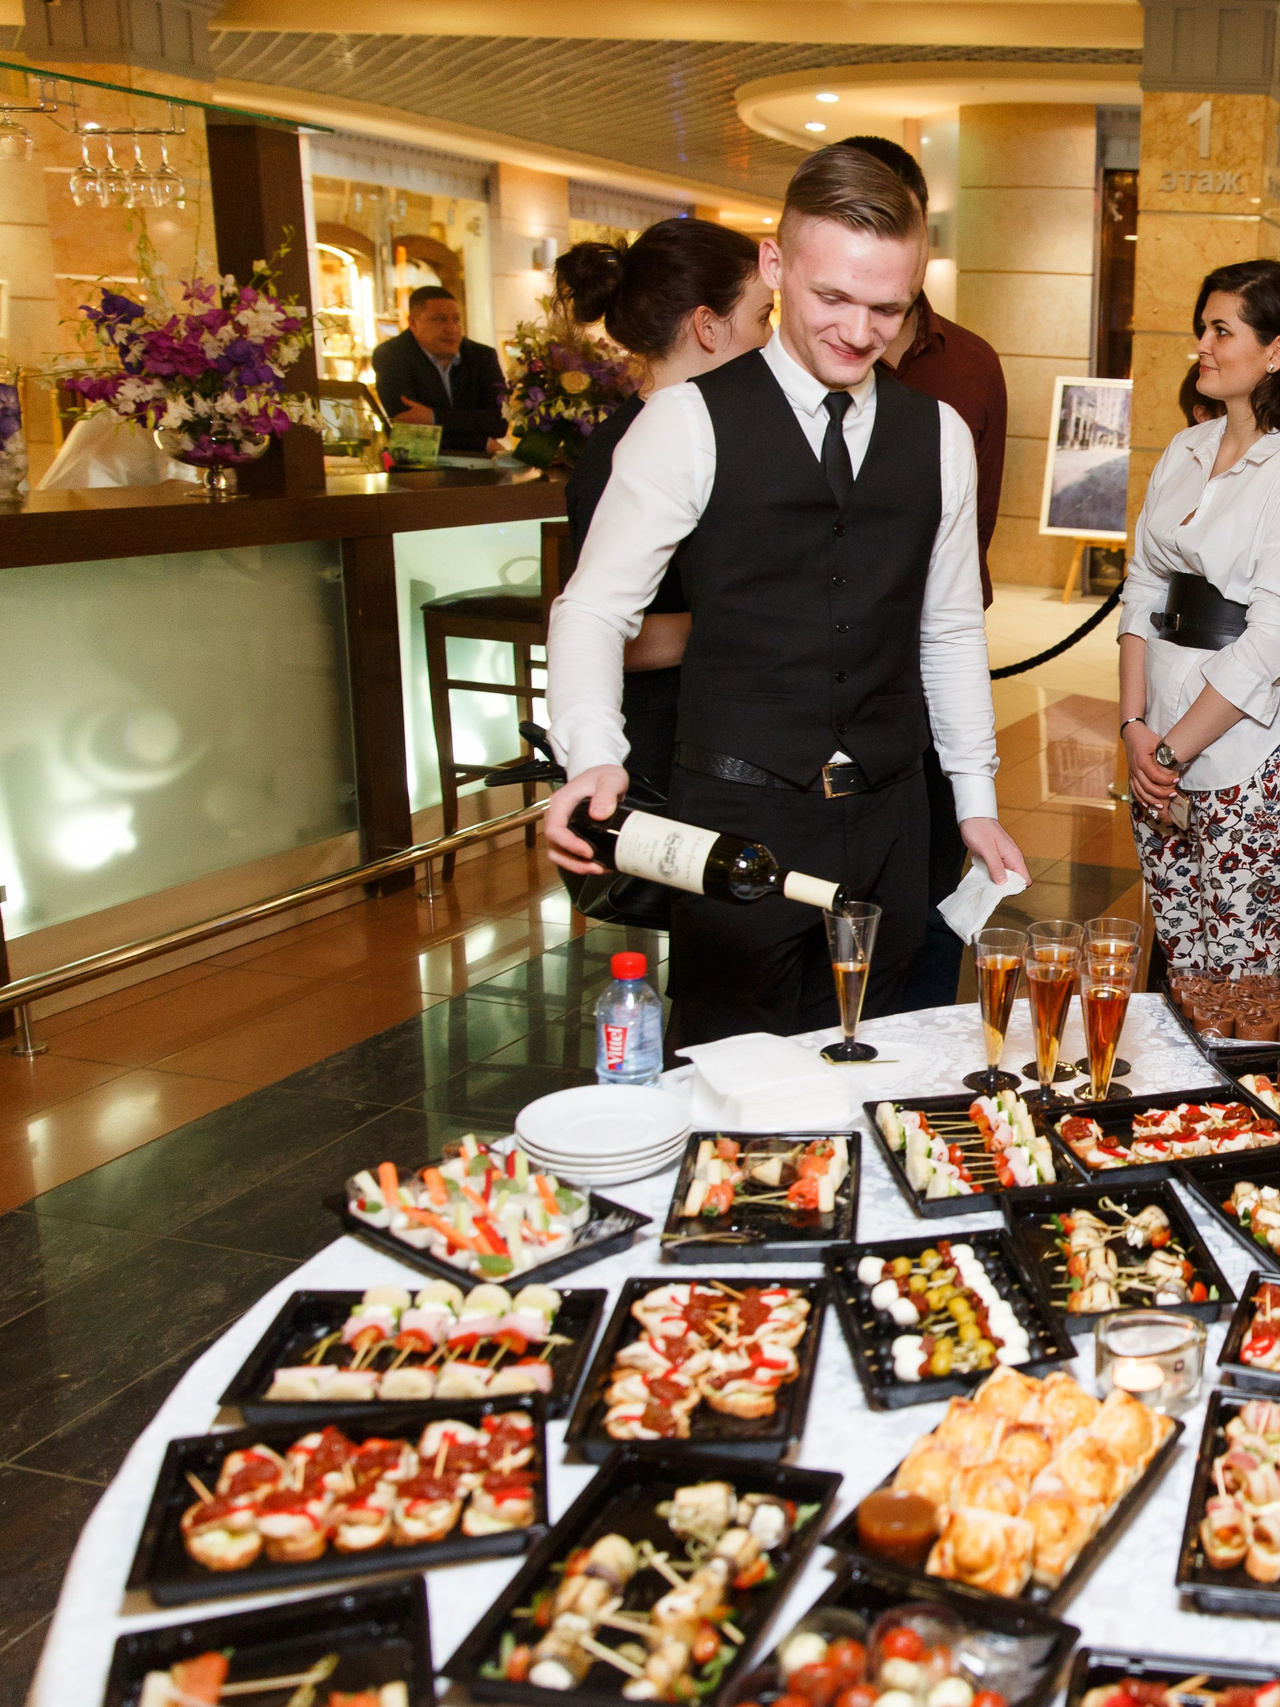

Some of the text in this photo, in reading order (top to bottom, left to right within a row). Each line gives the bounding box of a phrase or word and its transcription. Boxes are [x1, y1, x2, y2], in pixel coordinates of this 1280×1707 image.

[1187, 100, 1212, 158] 1
[1158, 169, 1244, 194] этаж
[607, 1027, 624, 1065] Vittel
